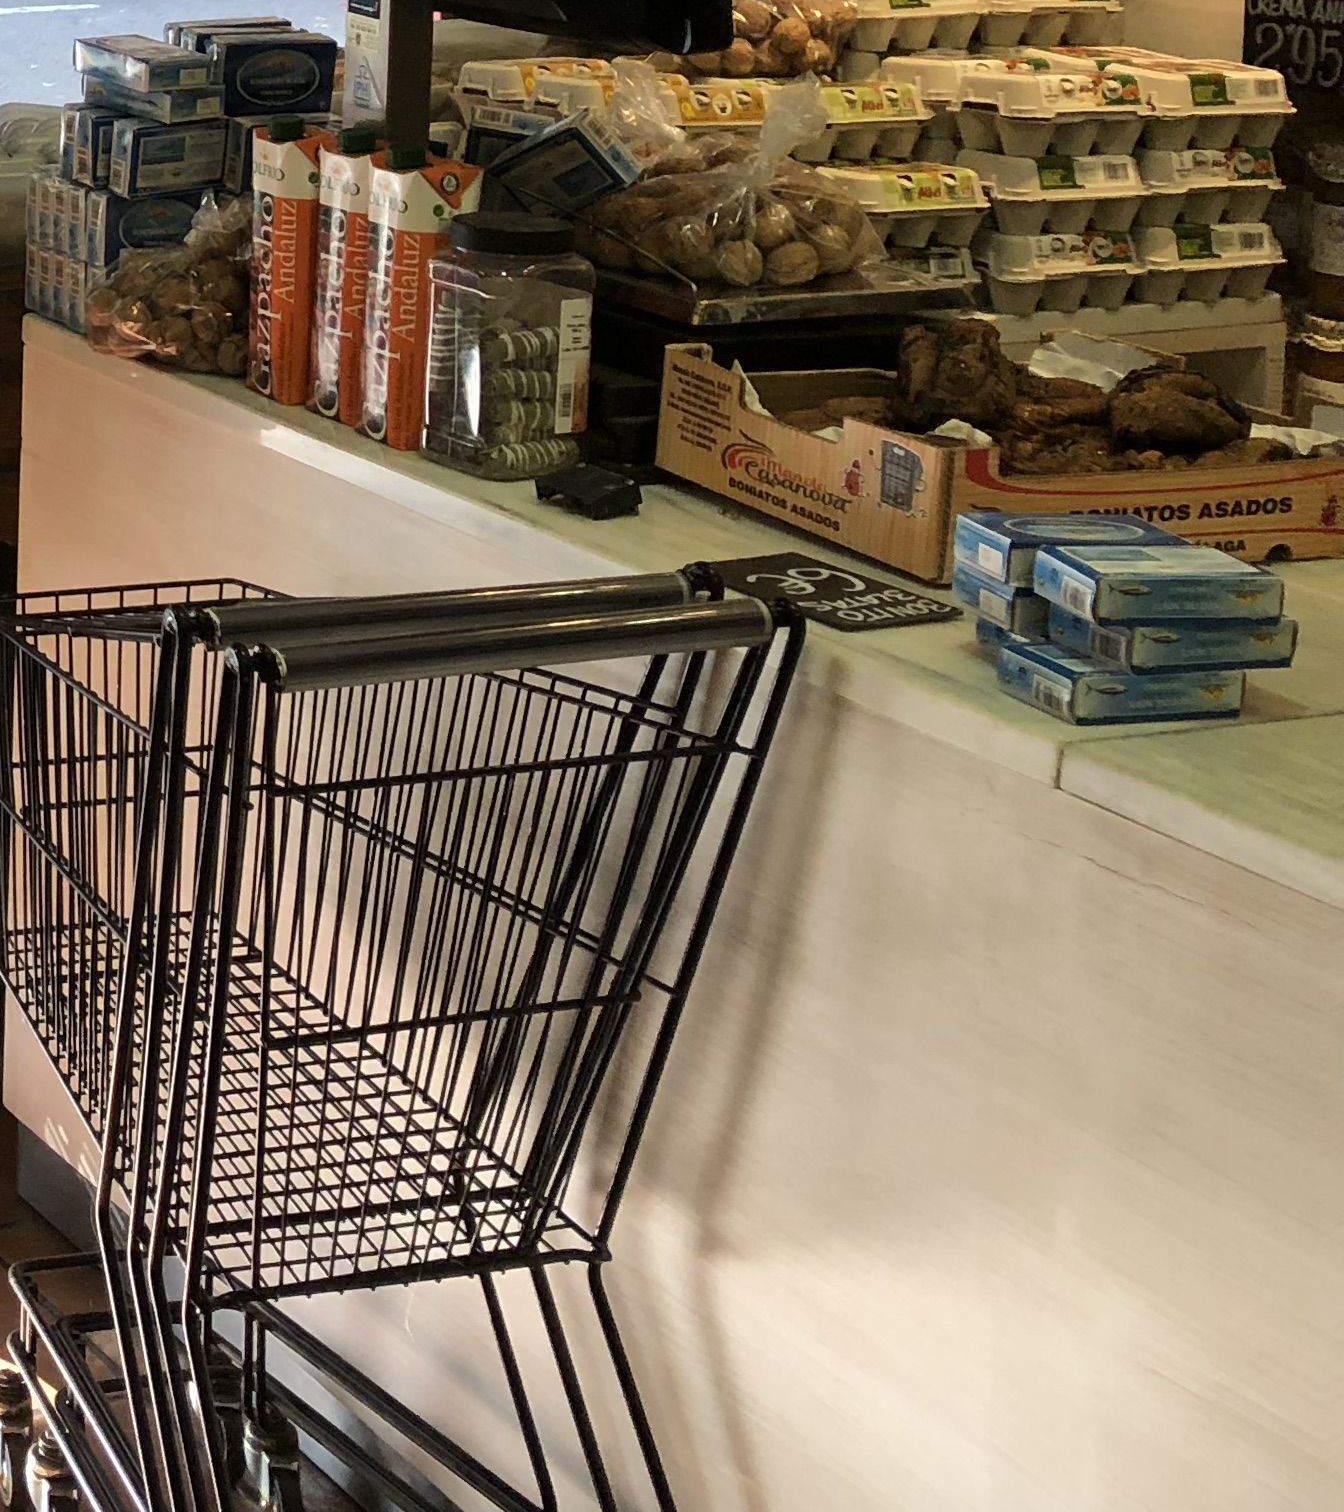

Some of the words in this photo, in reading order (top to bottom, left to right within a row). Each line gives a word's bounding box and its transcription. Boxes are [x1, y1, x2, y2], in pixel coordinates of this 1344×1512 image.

[274, 200, 297, 305] Andaluz
[251, 195, 282, 396] Gazpacho
[393, 234, 422, 344] Andaluz
[728, 475, 789, 510] BONIATOS
[790, 501, 841, 532] ASADOS
[744, 459, 854, 514] Casanova
[1196, 496, 1294, 520] ASADOS
[836, 598, 953, 623] BONITO
